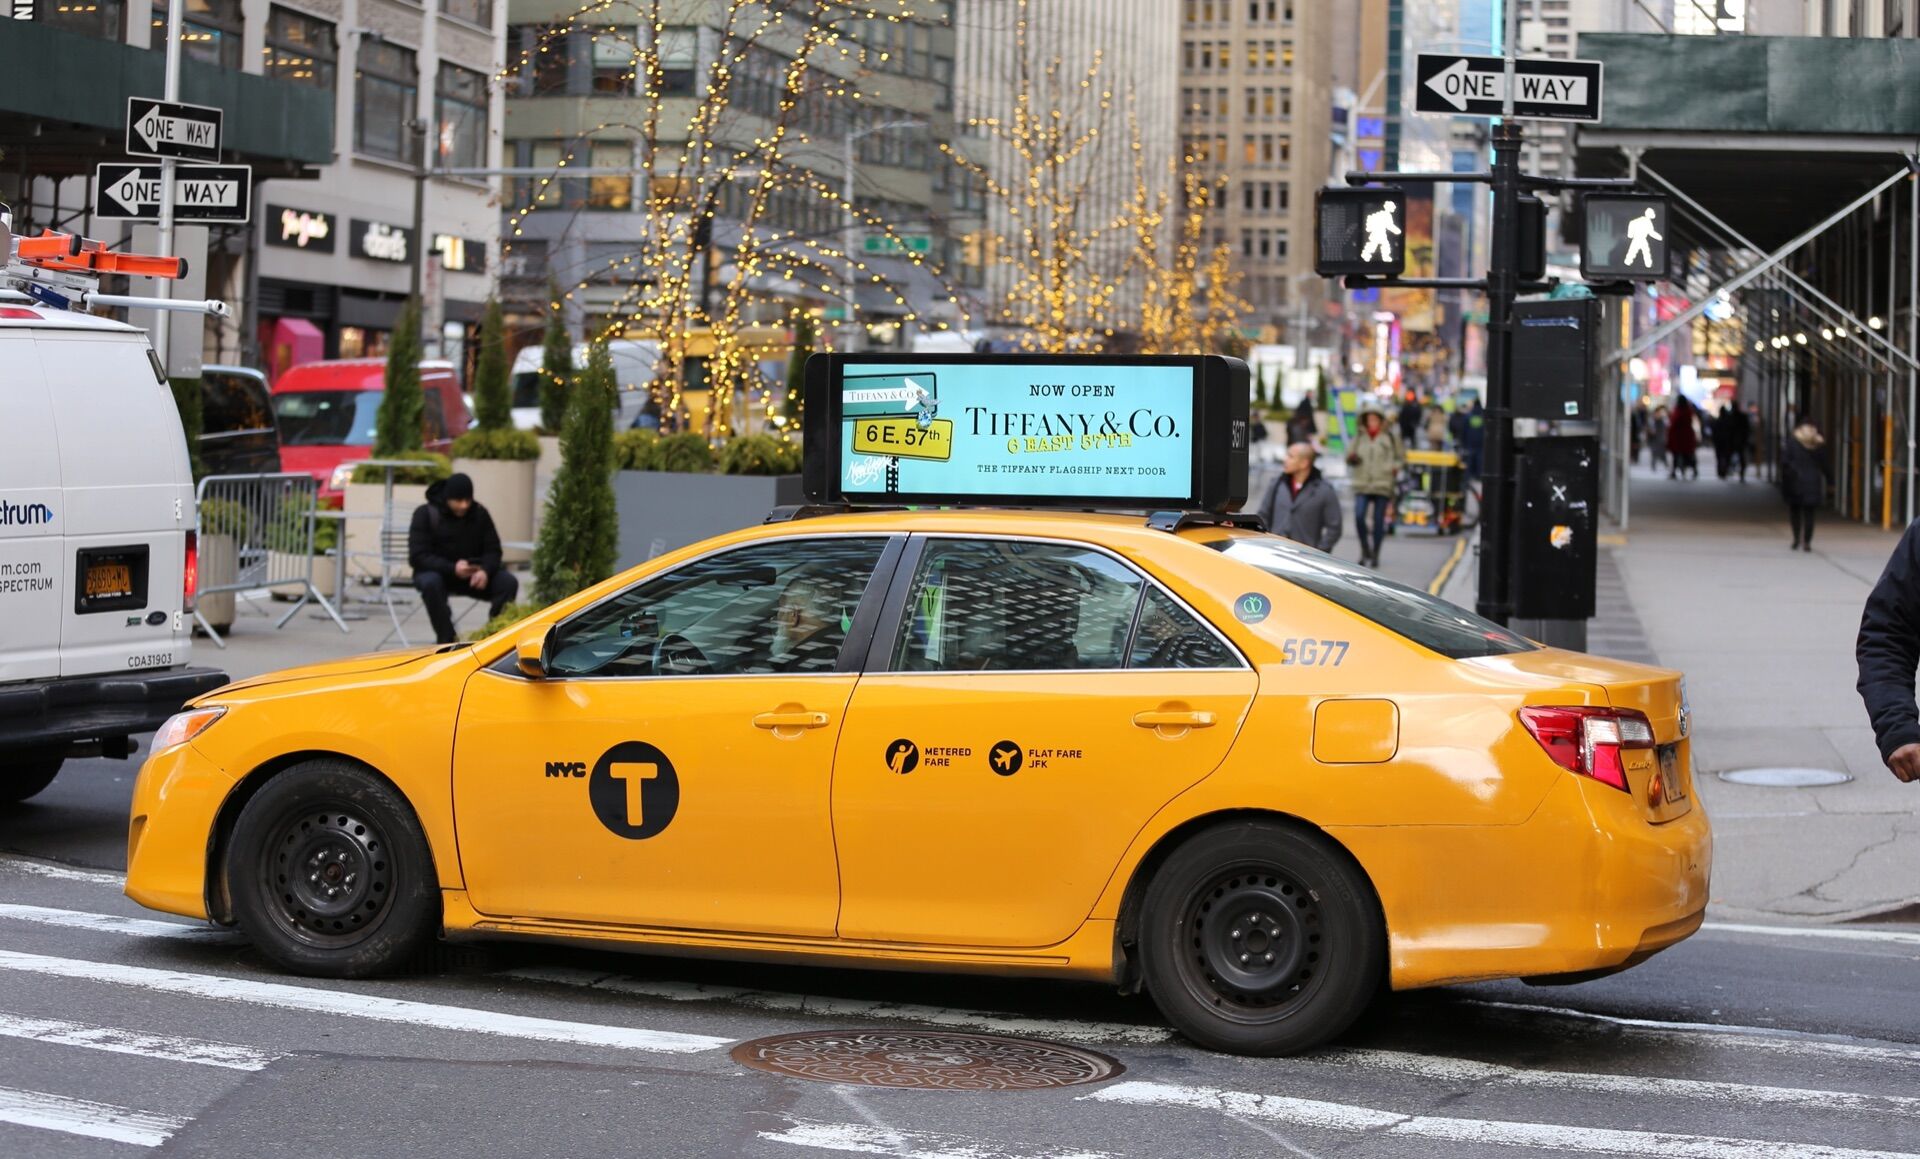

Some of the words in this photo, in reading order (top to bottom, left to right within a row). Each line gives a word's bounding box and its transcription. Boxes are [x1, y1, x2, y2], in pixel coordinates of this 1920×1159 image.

[1445, 74, 1495, 97] ONE
[1522, 77, 1576, 101] WAY
[145, 117, 174, 140] ONE
[187, 122, 211, 145] WAY
[121, 182, 161, 202] ONE
[184, 183, 228, 204] WAY
[1029, 384, 1065, 397] NOW
[1071, 384, 1116, 397] OPEN
[866, 424, 878, 442] 6
[882, 425, 899, 445] E.
[904, 426, 940, 446] 57th
[1007, 437, 1019, 455] 6
[1023, 434, 1074, 453] EAST
[1080, 432, 1132, 450] 57TH
[977, 464, 998, 473] THE
[1001, 464, 1046, 474] TIFFANY
[1049, 465, 1102, 475] FLAGSHIP
[1105, 466, 1135, 475] NEXT
[1137, 467, 1167, 476] DOOR
[128, 653, 172, 667] CDA31903
[1281, 638, 1349, 666] 5G77
[924, 747, 971, 756] METERED
[1028, 749, 1053, 758] FLAT
[1056, 750, 1082, 758] FARE
[545, 762, 586, 778] NYC
[924, 758, 950, 767] FARE
[1028, 760, 1048, 768] JFK
[610, 762, 658, 827] T
